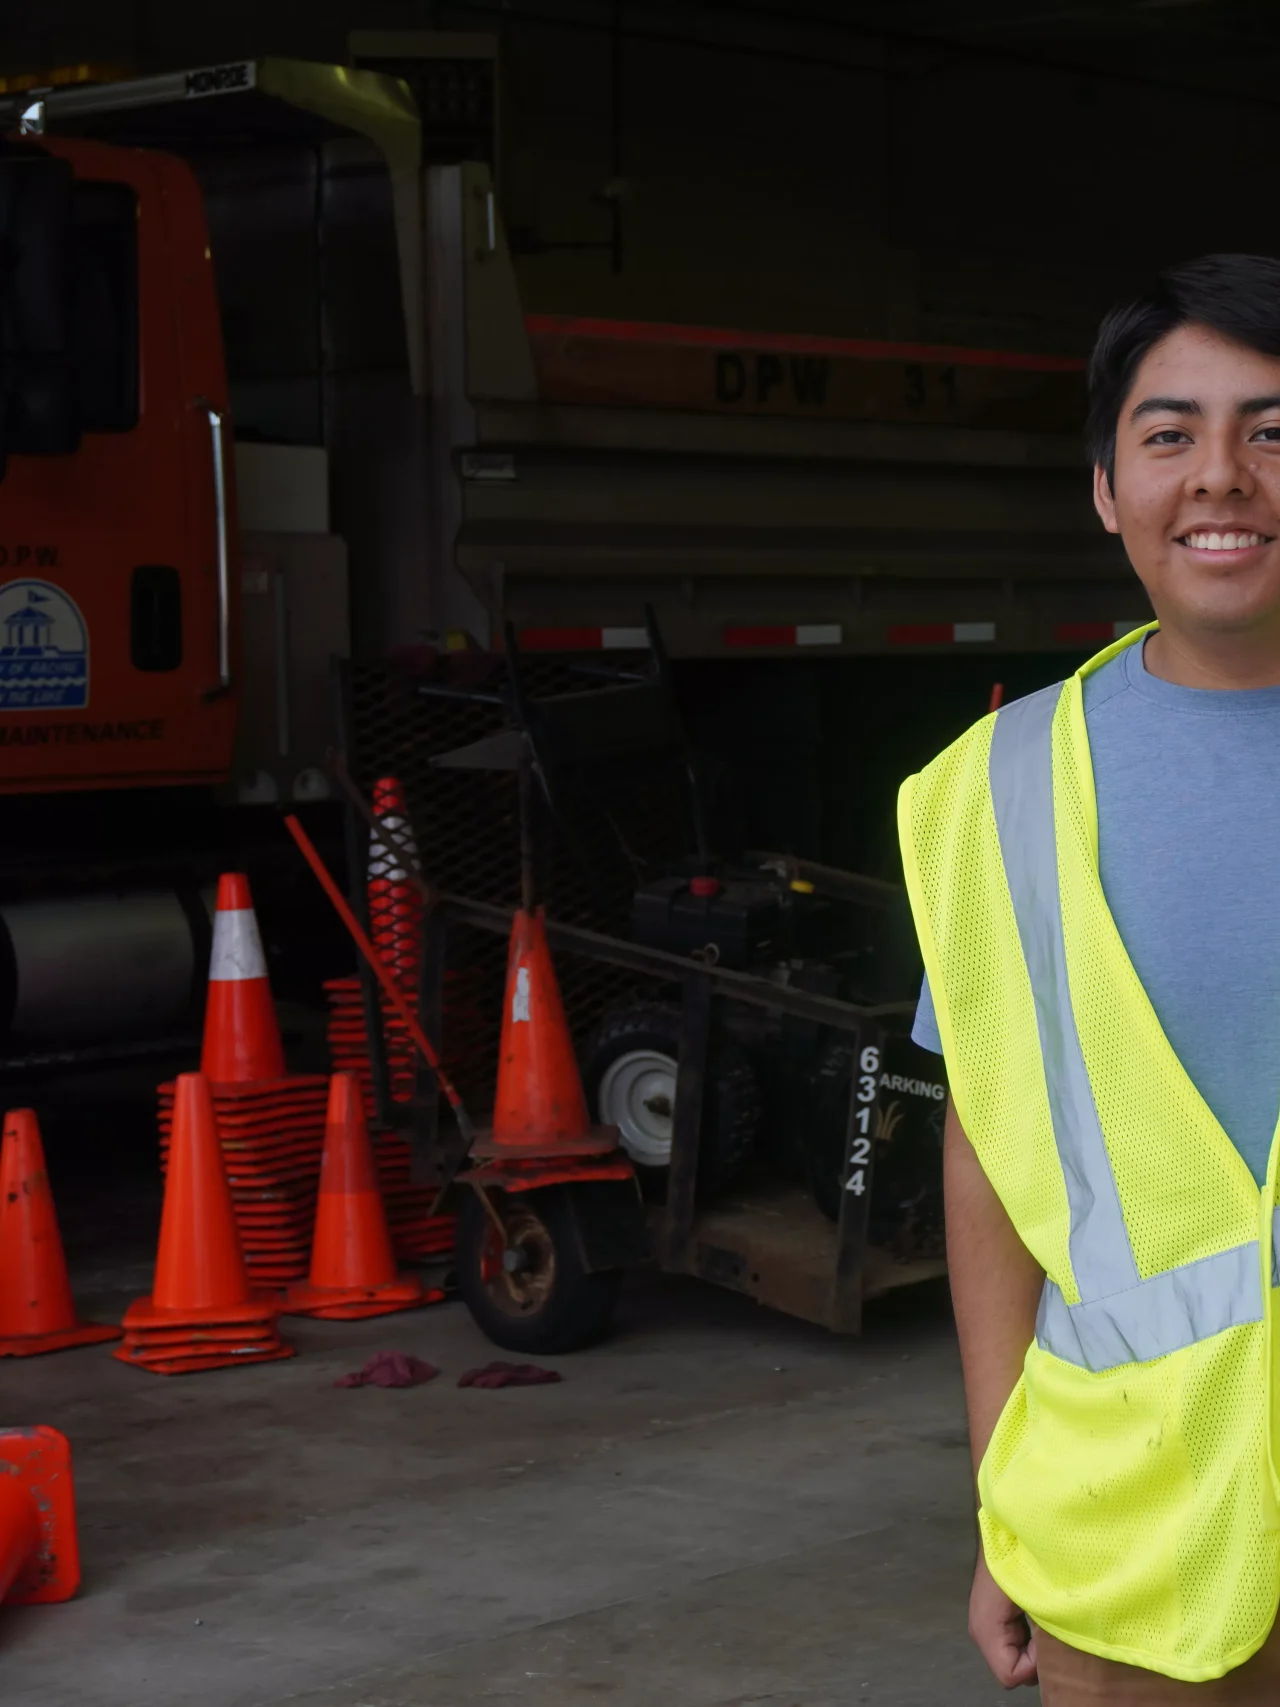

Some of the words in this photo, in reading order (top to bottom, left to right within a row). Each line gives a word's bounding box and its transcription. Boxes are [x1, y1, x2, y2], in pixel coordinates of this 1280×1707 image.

[186, 64, 248, 94] MONROE
[716, 353, 830, 405] DPW
[905, 363, 956, 411] 31
[879, 1072, 945, 1101] ARKING
[845, 1046, 880, 1196] 63124
